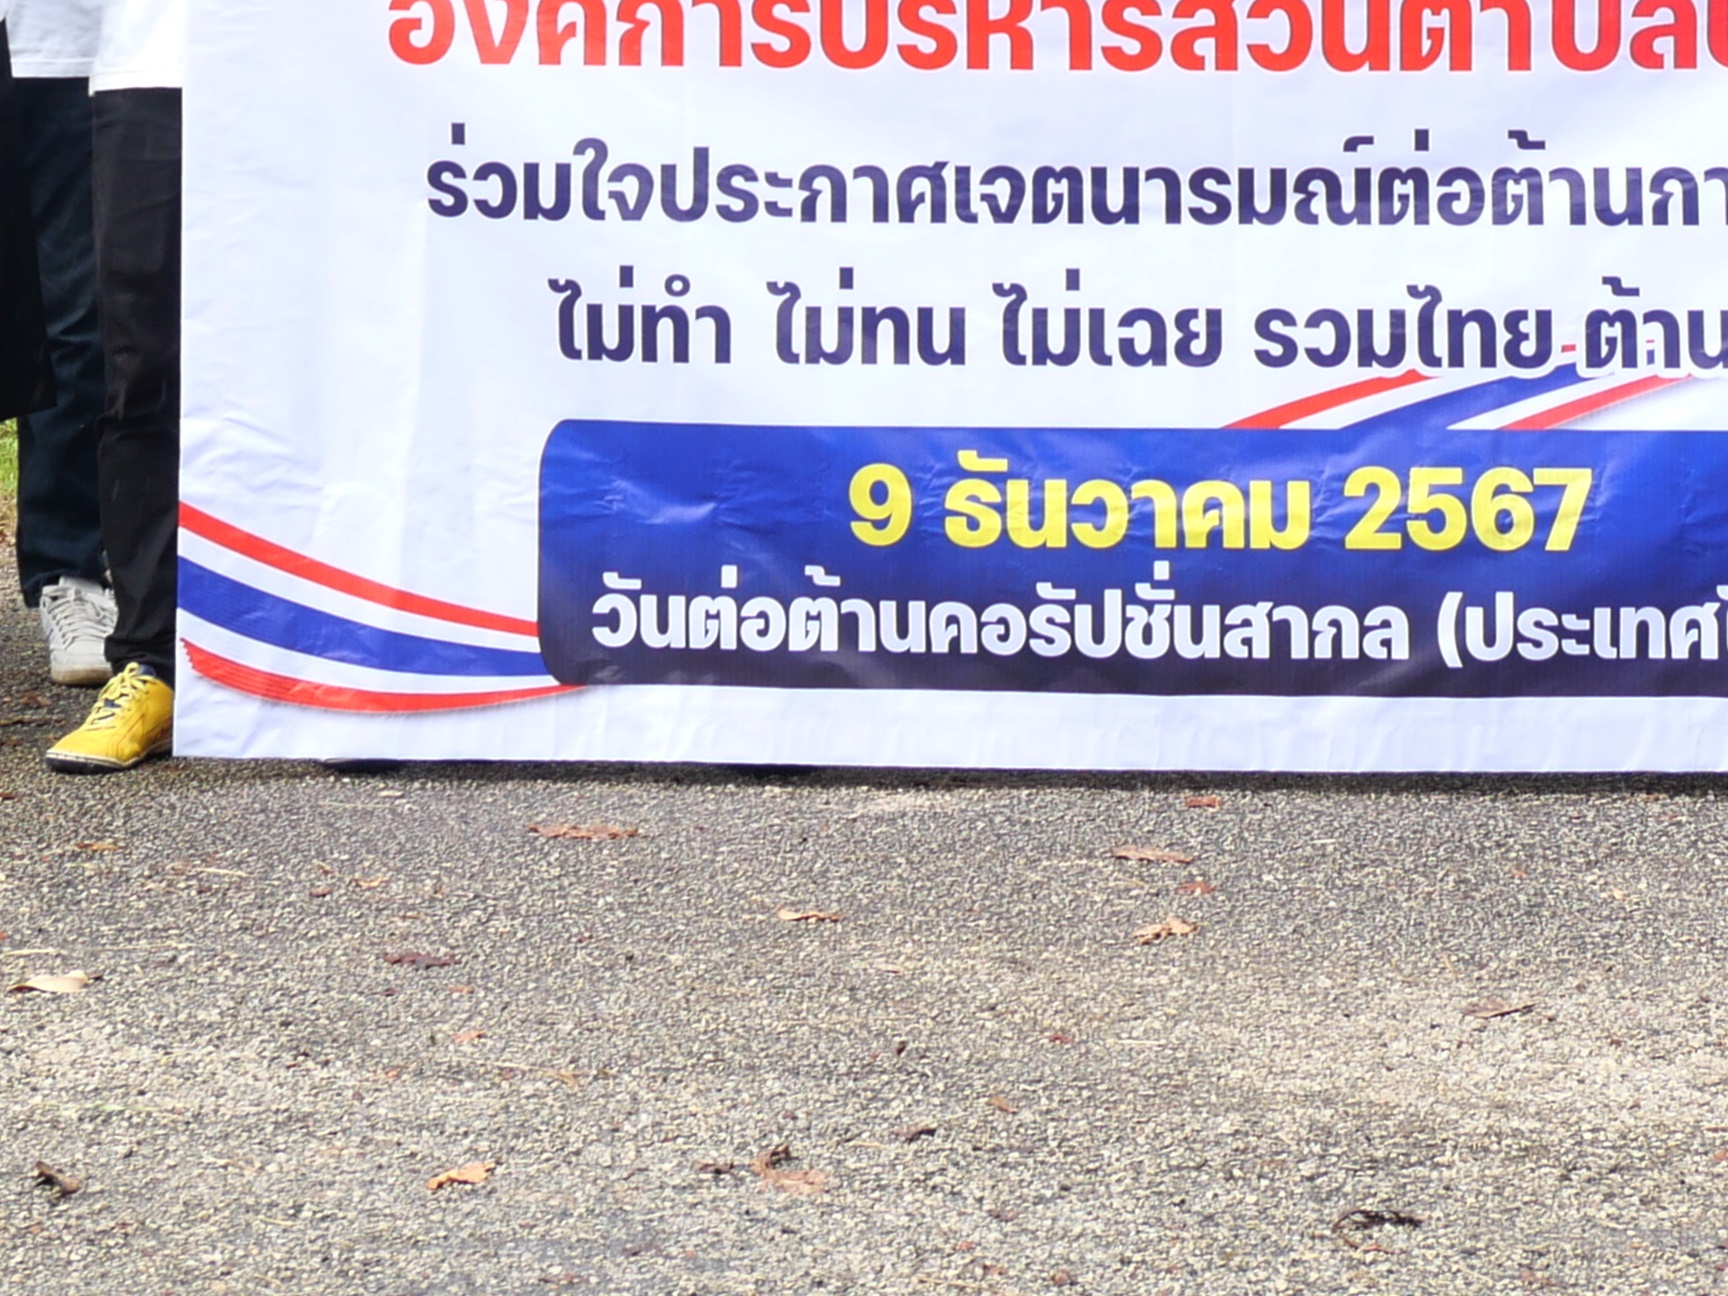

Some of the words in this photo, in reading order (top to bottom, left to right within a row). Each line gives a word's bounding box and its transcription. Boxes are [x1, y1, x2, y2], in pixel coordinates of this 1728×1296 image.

[548, 264, 731, 370] ไม่ทำ
[766, 265, 967, 370] ไม่ทน
[992, 266, 1223, 370] ไม่เฉย
[1256, 276, 1552, 370] รวมไทย
[850, 464, 912, 546] 9
[946, 452, 1310, 550] ธันวาคม
[1345, 467, 1590, 551] 2567
[590, 561, 1412, 666] วันต่อต้านคอรัปชั่นสากล
